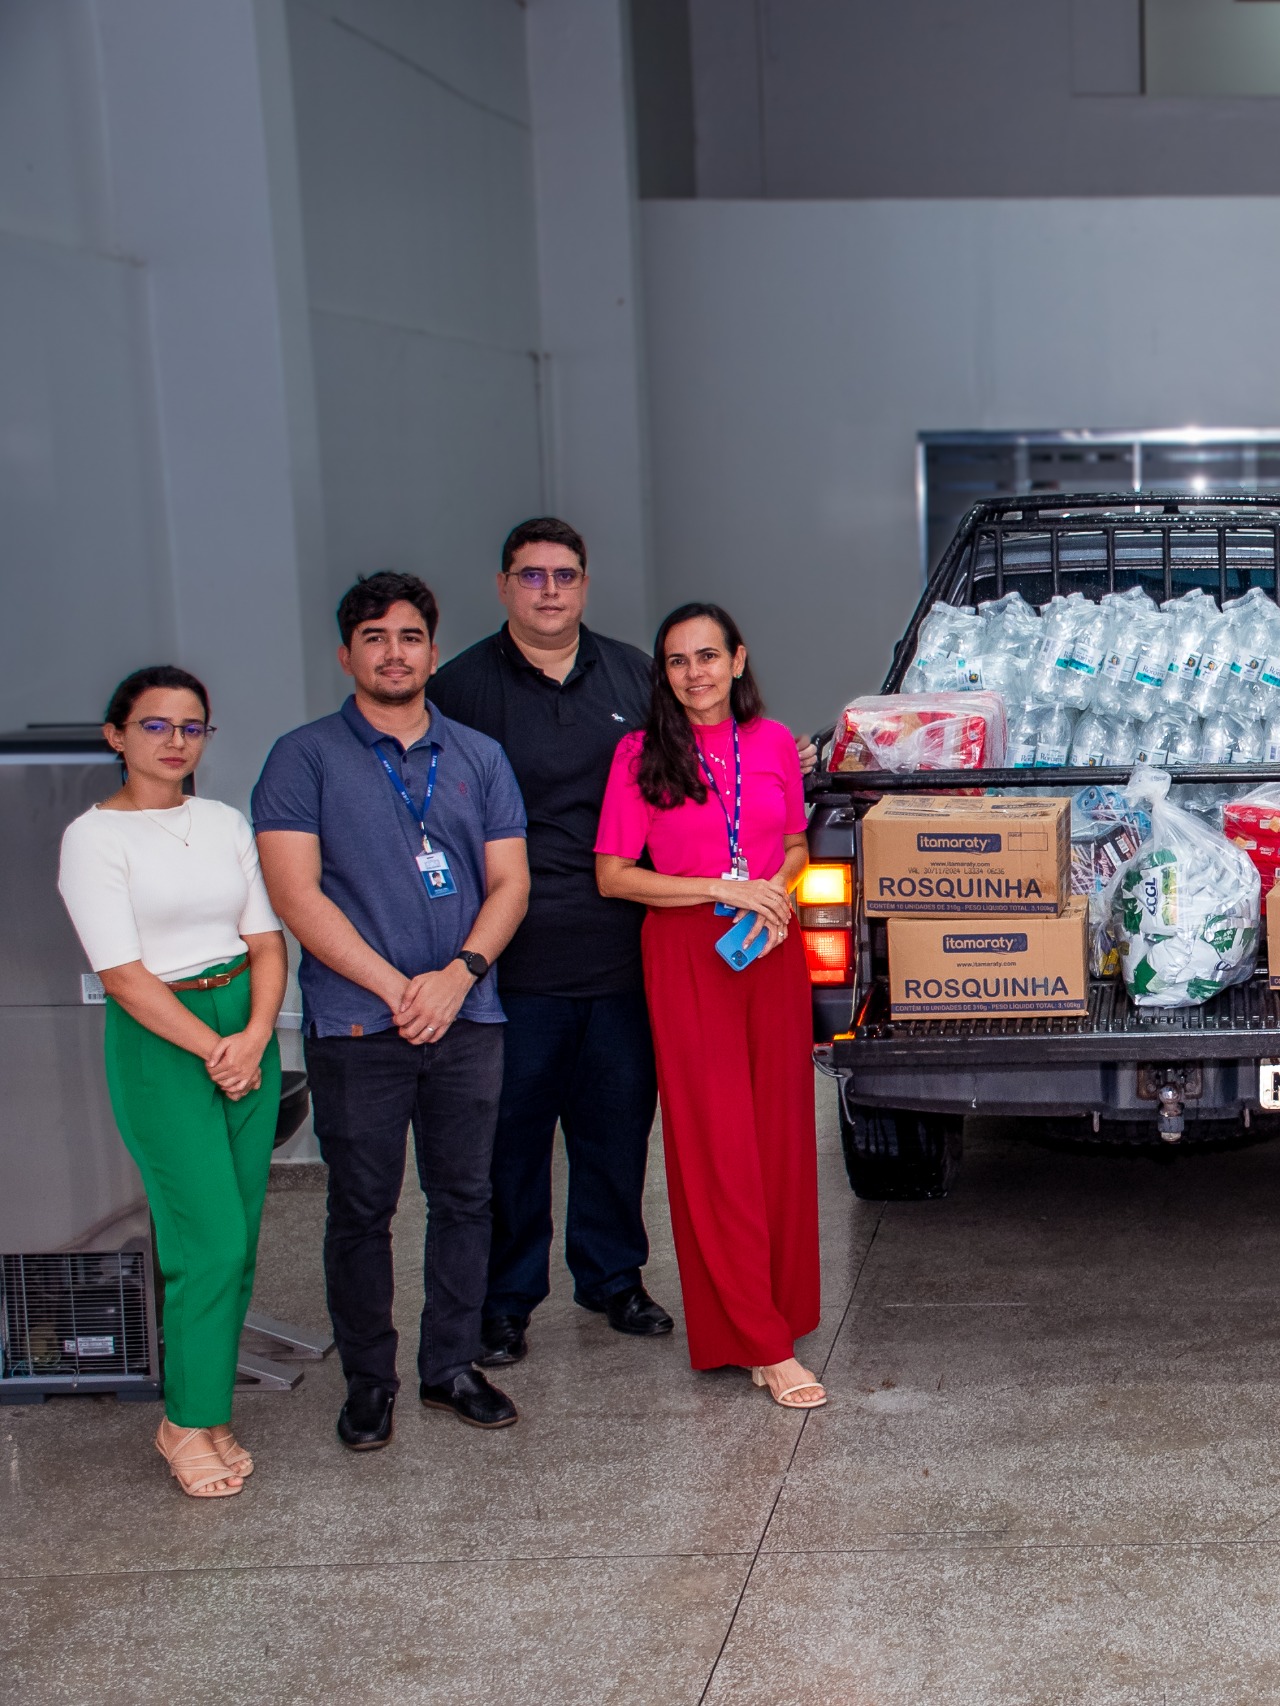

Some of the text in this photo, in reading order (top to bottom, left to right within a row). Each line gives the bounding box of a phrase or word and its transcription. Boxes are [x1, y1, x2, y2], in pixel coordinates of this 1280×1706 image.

[920, 834, 988, 852] itamaraty
[930, 861, 990, 869] www.itamaraty.com
[879, 877, 1042, 899] ROSQUINHA
[945, 936, 1014, 952] itamaraty
[904, 976, 1069, 999] ROSQUINHA
[895, 1004, 922, 1012] CONTÉM
